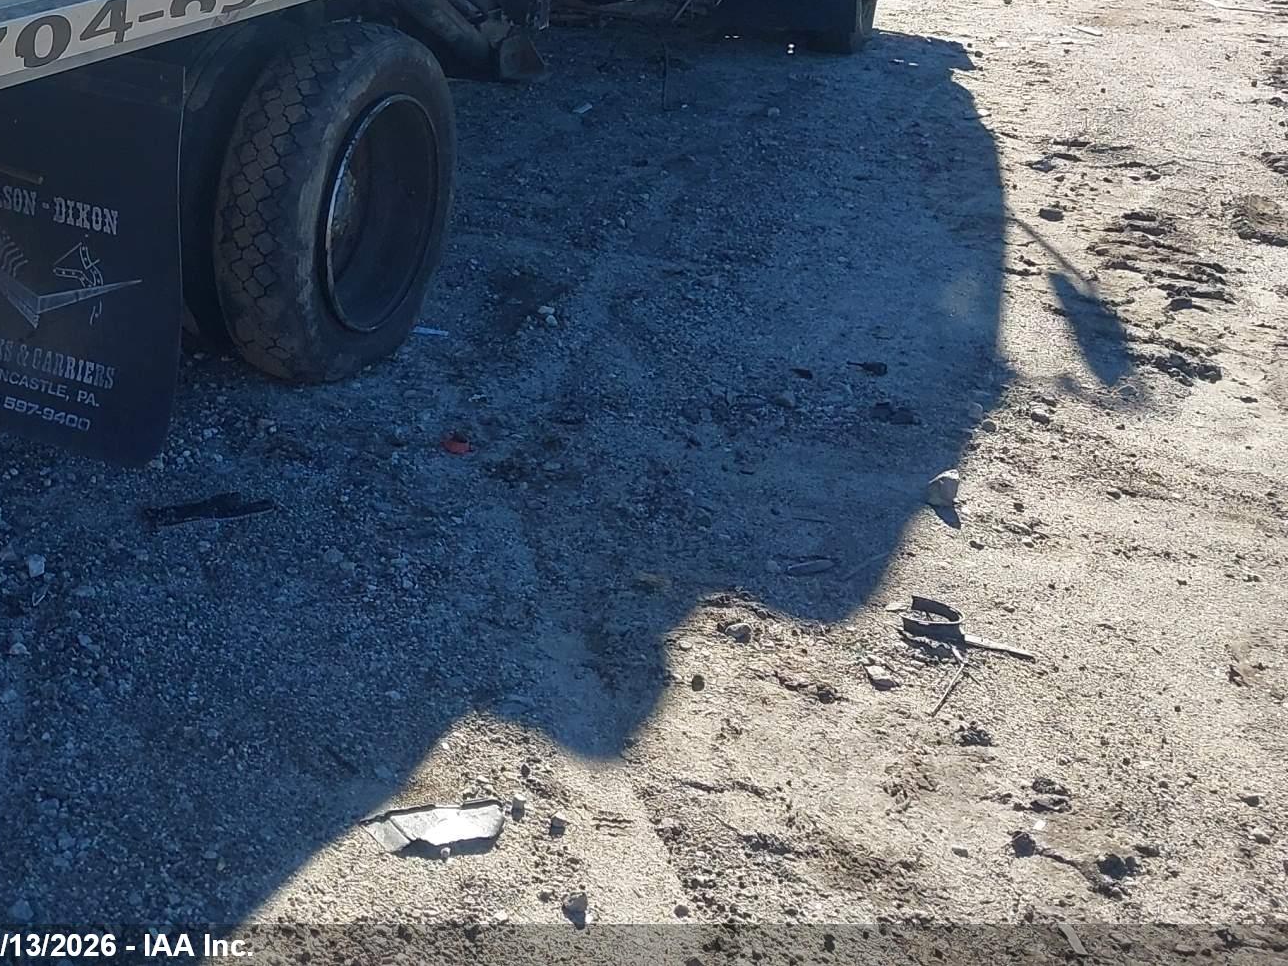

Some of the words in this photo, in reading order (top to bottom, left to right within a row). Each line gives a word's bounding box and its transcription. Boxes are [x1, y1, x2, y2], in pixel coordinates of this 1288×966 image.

[53, 197, 118, 235] DIXON
[16, 344, 30, 367] &
[32, 347, 116, 389] CARRIERS
[3, 396, 91, 431] 597-9400
[77, 390, 100, 407] PA.
